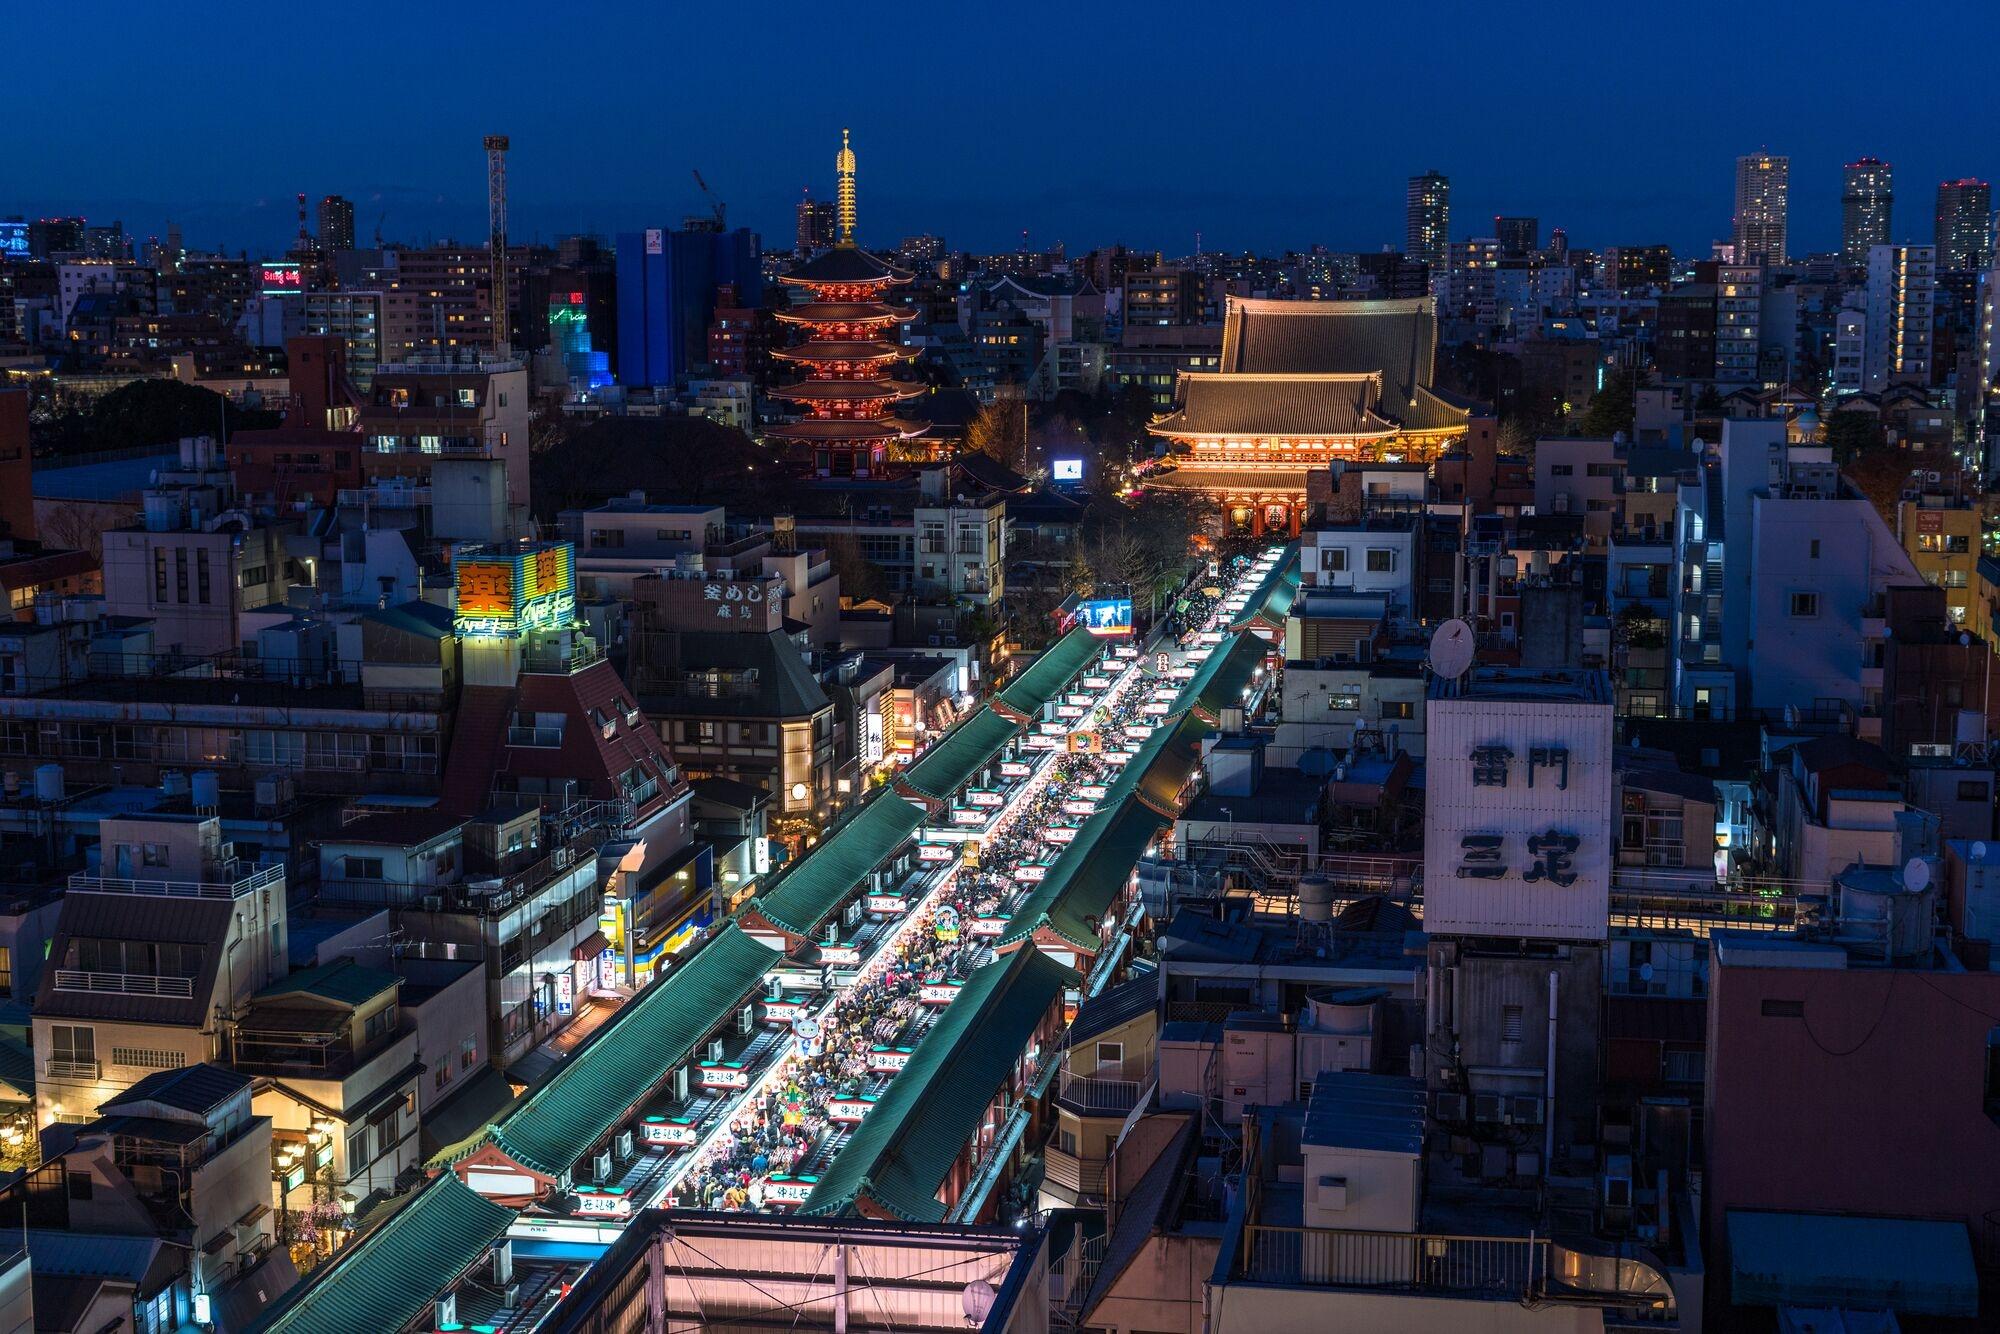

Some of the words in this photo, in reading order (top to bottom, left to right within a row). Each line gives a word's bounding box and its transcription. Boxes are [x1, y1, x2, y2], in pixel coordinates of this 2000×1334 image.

[459, 561, 512, 612] 薬
[704, 584, 762, 602] 釜めし
[1469, 745, 1569, 790] 雷門
[1456, 829, 1581, 888] 三定
[562, 976, 570, 1000] コーヒー
